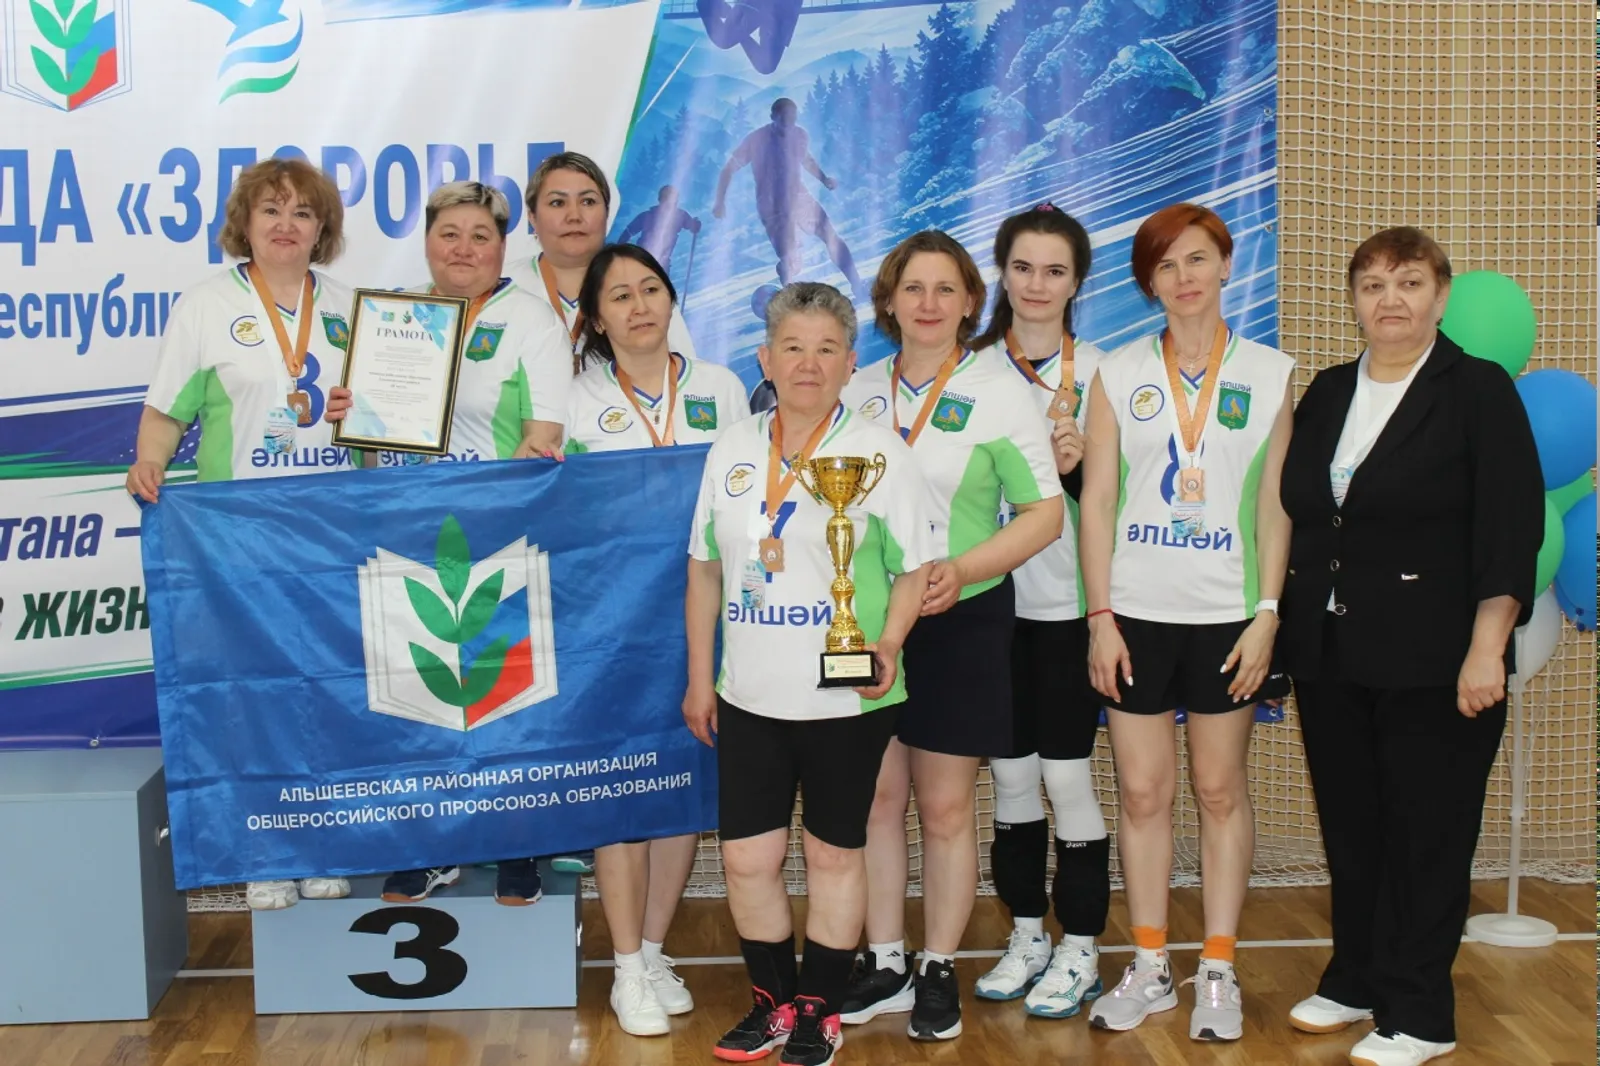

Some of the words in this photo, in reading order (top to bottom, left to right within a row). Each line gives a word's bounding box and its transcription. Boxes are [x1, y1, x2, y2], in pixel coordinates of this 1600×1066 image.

[376, 327, 434, 341] ГРАМОТА
[0, 513, 104, 561] тана
[760, 501, 797, 583] 7
[246, 802, 434, 831] ОБЩЕРОССИЙСКОГО
[440, 792, 562, 817] ПРОФСОЮЗА
[565, 772, 692, 804] ОБРАЗОВАНИЯ
[279, 777, 417, 802] АЛЬШЕЕВСКАЯ
[422, 768, 523, 792] РАЙОННАЯ
[528, 752, 657, 782] ОРГАНИЗАЦИЯ
[347, 905, 468, 1000] 3
